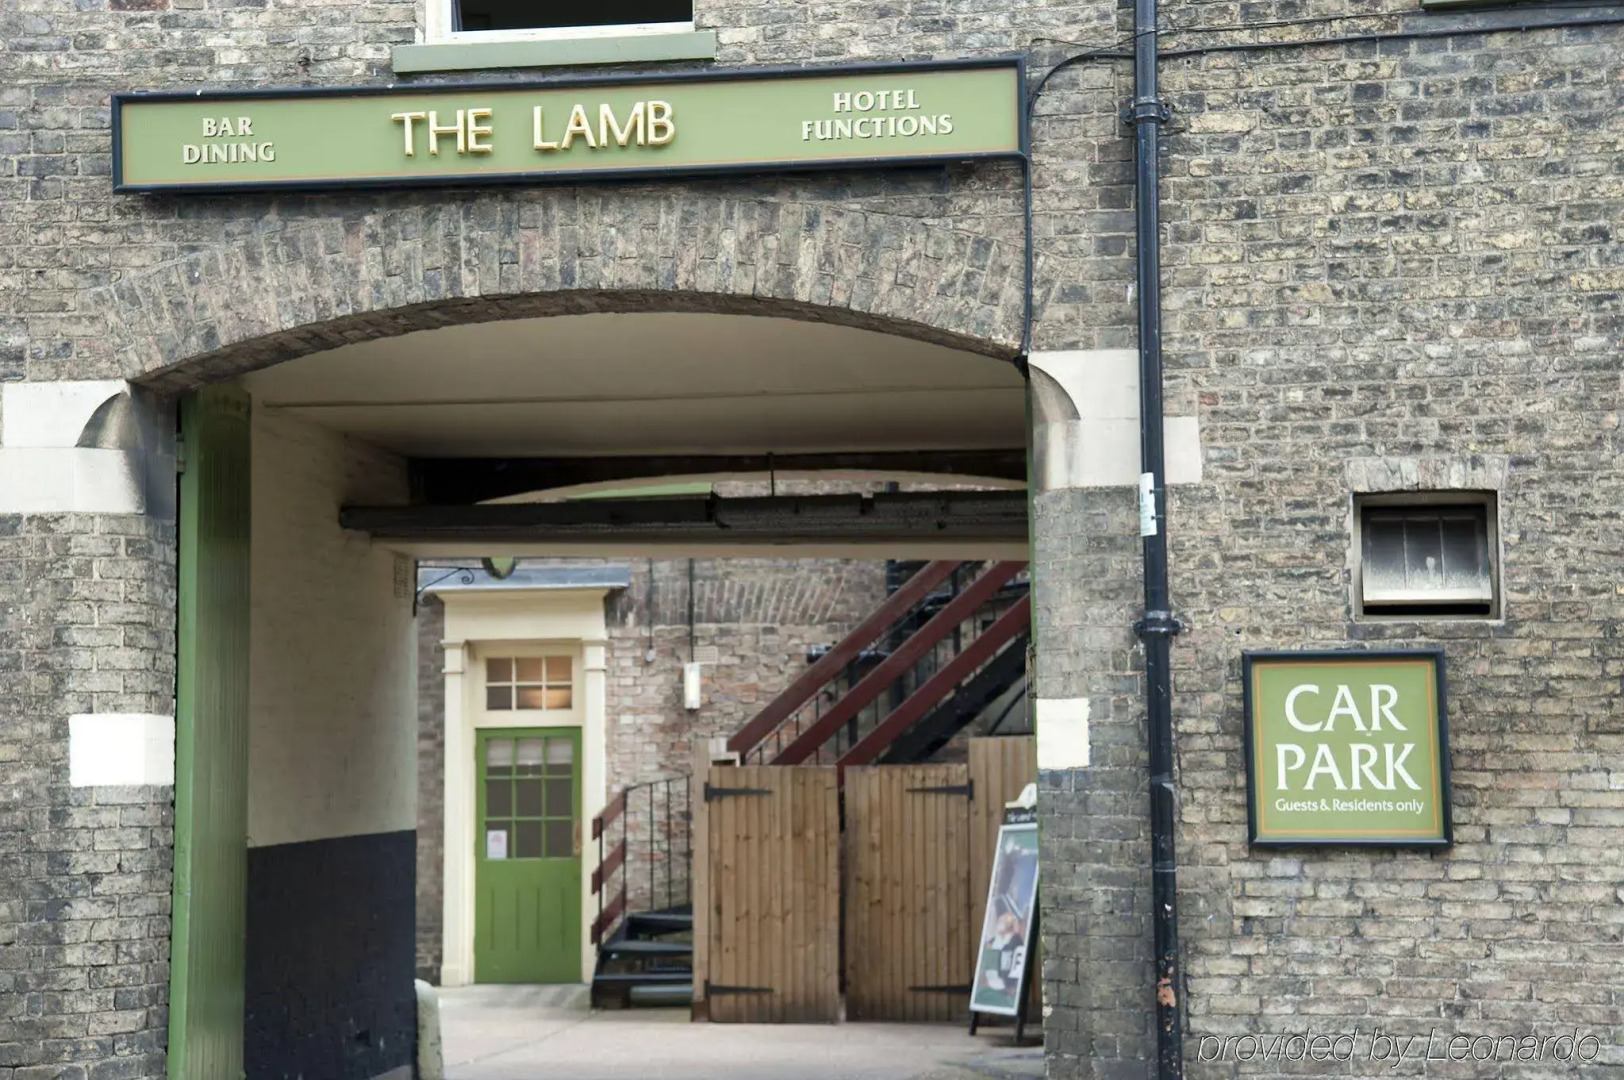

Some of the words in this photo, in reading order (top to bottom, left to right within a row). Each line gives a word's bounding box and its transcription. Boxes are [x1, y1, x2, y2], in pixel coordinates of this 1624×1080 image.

[833, 89, 921, 112] HOTEL
[202, 116, 253, 138] BAR
[391, 108, 493, 156] THE
[532, 101, 676, 150] LAMB
[801, 114, 954, 141] FUNCTIONS
[182, 142, 276, 165] DINING
[1284, 683, 1408, 733] CAR
[1275, 743, 1422, 791] PARK
[1275, 798, 1318, 812] Guests
[1320, 799, 1330, 812] &
[1332, 799, 1394, 812] Residents
[1396, 799, 1424, 815] only
